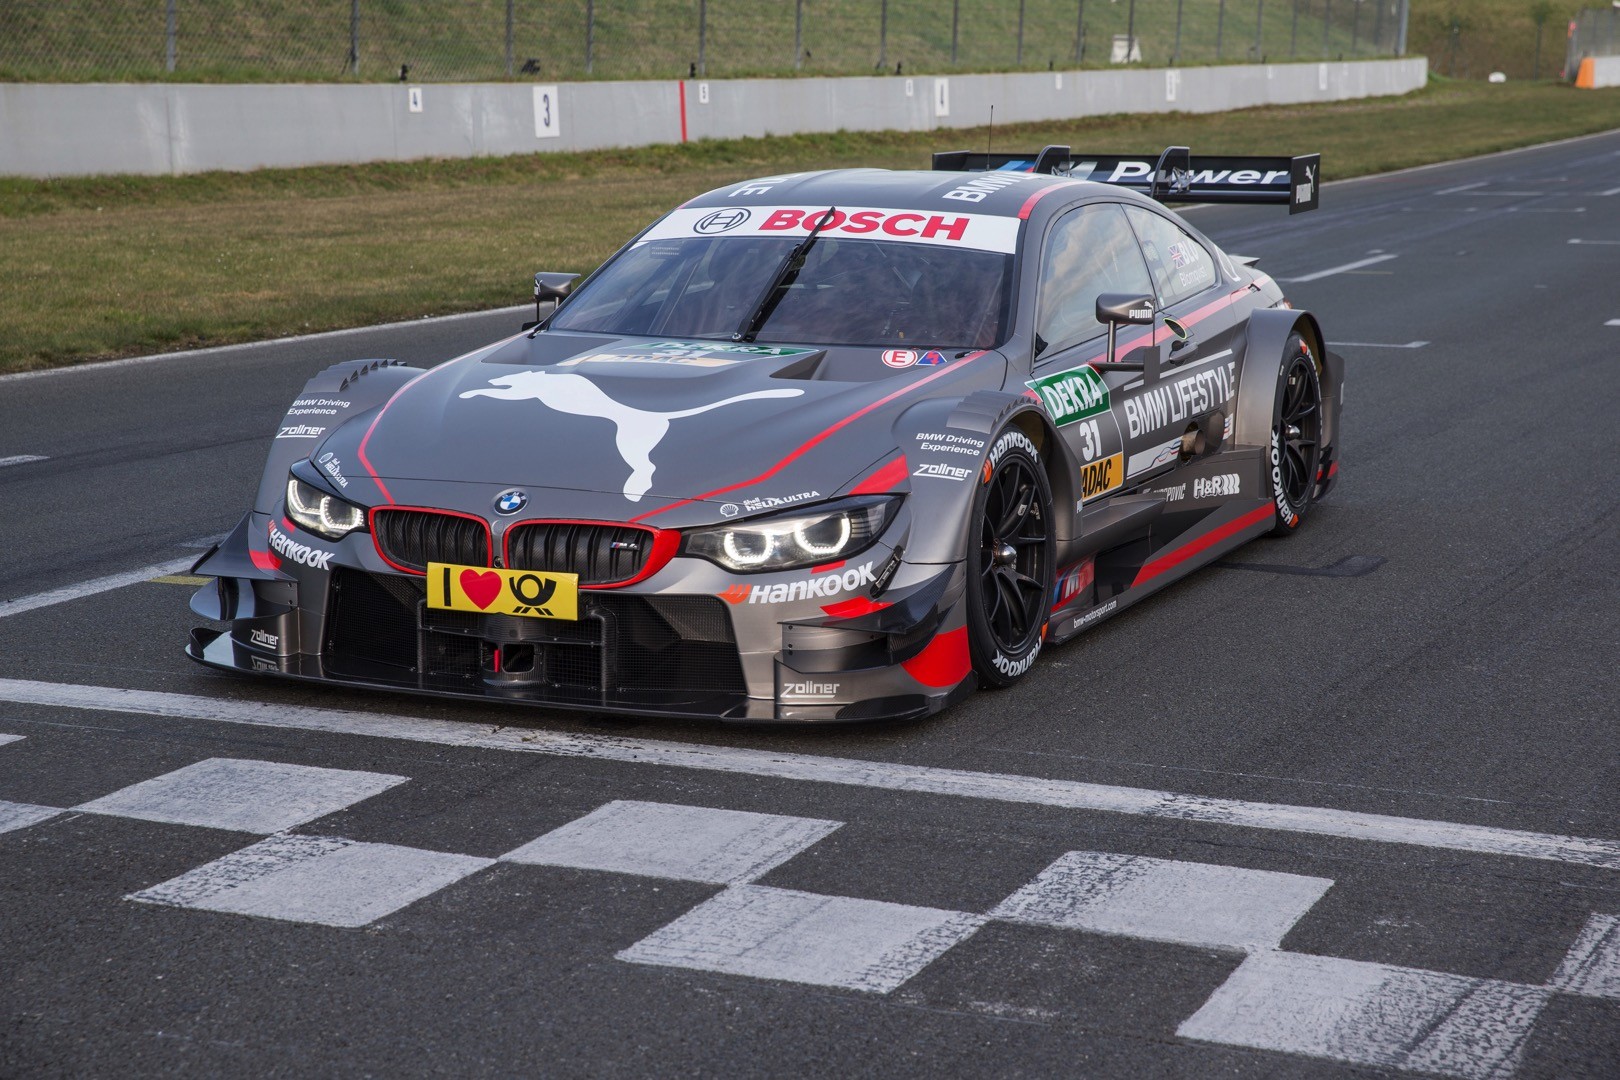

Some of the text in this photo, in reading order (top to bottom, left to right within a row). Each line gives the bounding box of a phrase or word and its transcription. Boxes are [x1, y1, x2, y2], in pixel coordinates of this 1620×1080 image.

[543, 93, 551, 127] 3
[758, 210, 970, 241] BOSCH
[892, 351, 907, 363] E
[292, 399, 351, 408] BMW Driving
[1041, 373, 1103, 419] DEKRA
[1123, 385, 1168, 440] BMW
[1167, 361, 1236, 429] LIFESTYLE
[287, 407, 337, 415] Experience
[915, 432, 985, 448] BMW Driving
[920, 442, 980, 456] Experience
[1080, 419, 1102, 462] 31
[1081, 458, 1112, 498] ADAC
[1194, 475, 1222, 499] H&R
[783, 490, 821, 504] ULTRA
[443, 567, 452, 607] I
[1073, 600, 1117, 628] bmw-motorsport.com
